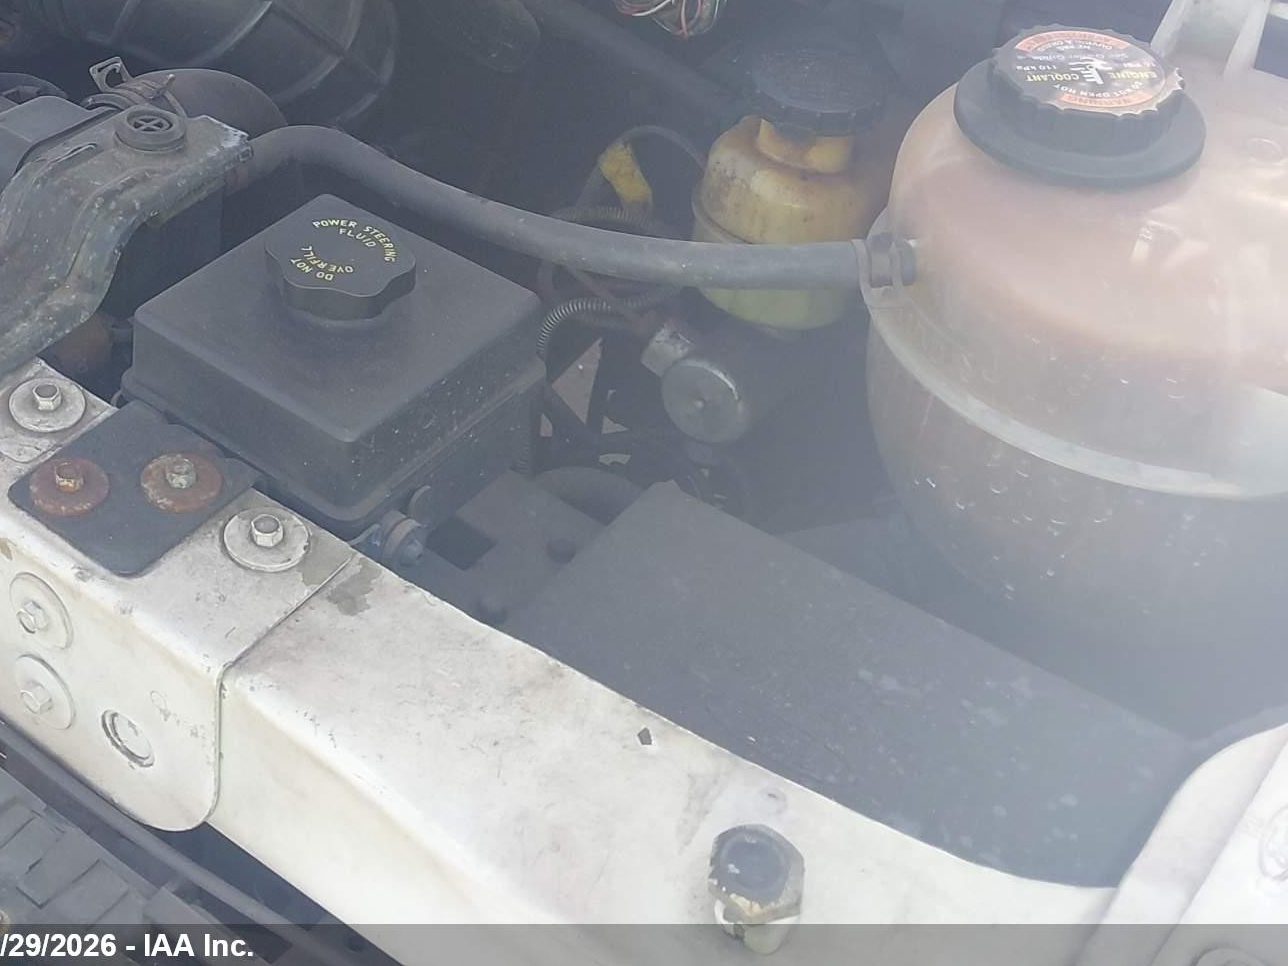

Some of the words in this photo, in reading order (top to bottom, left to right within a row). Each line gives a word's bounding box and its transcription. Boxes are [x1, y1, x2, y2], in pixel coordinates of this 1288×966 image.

[1026, 73, 1079, 81] COOLANT
[1052, 84, 1077, 94] HOT
[1079, 89, 1109, 98] OPEN
[312, 219, 358, 229] POWER
[362, 226, 397, 263] STEERING
[339, 228, 377, 248] FLUID
[289, 257, 313, 274] NOT
[300, 245, 355, 274] OVERFILL
[315, 271, 335, 281] DO
